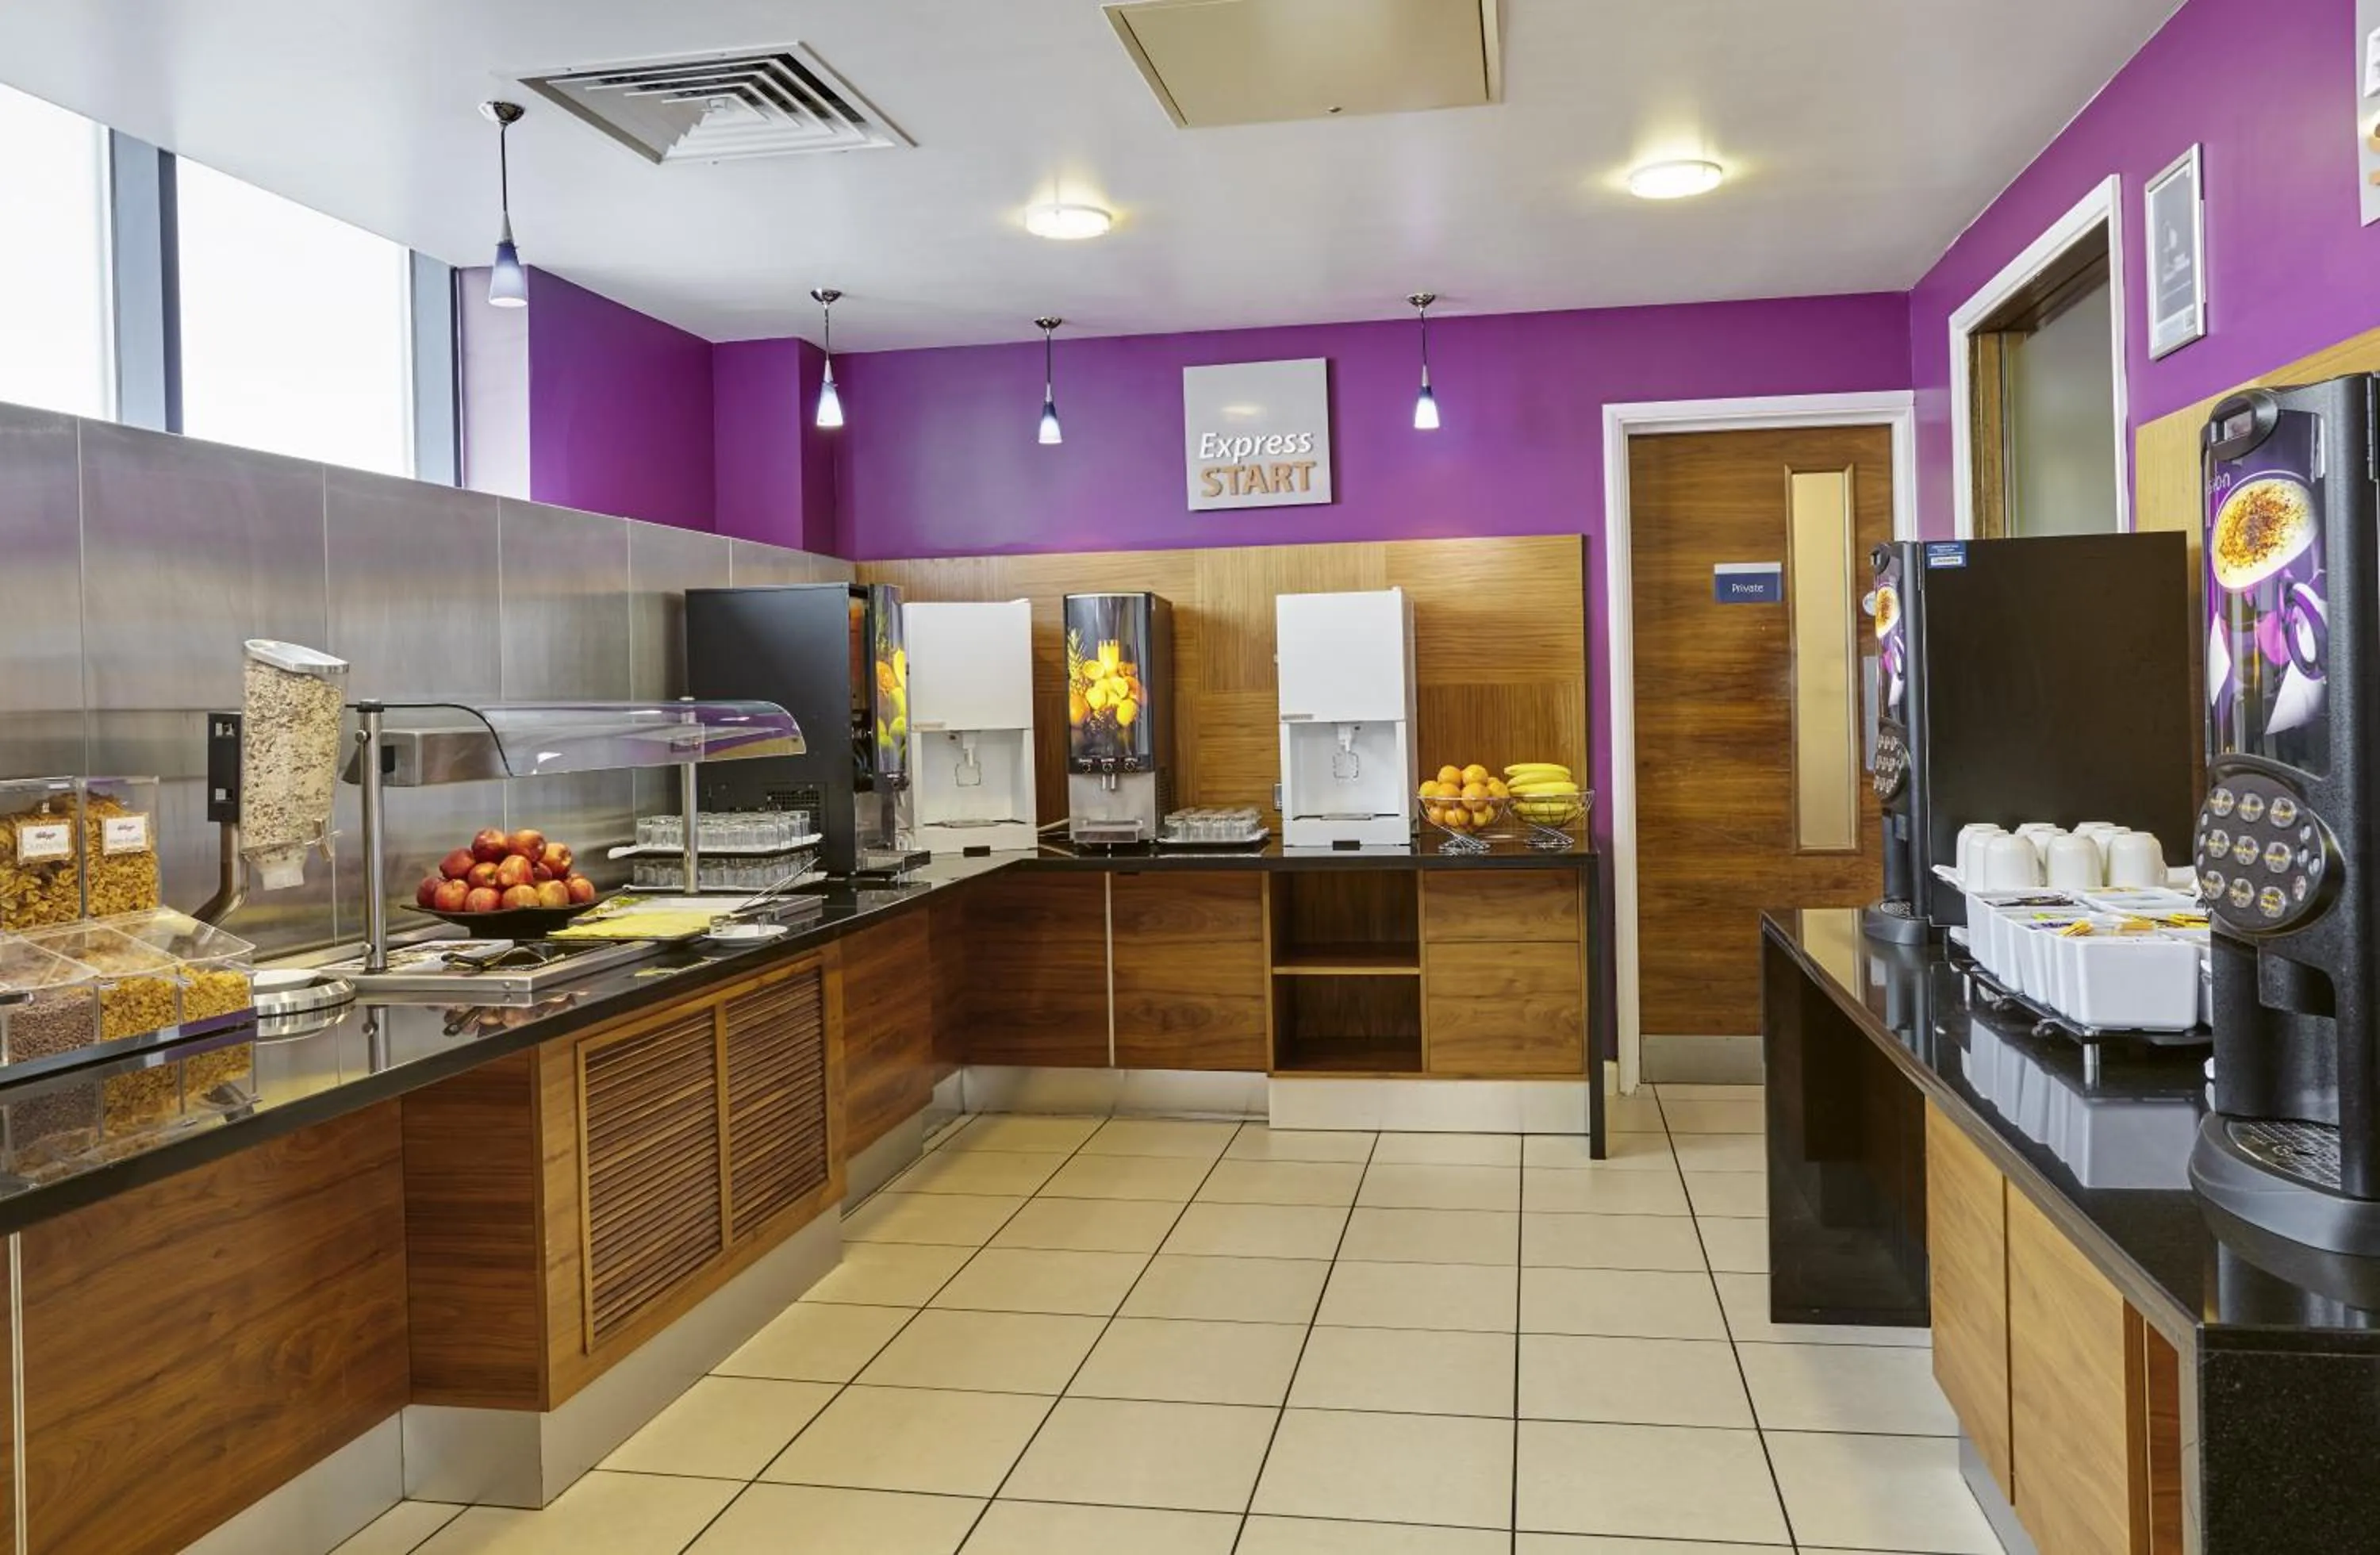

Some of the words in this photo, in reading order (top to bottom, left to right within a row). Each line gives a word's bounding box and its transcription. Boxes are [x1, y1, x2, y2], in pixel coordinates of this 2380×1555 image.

[1199, 432, 1313, 464] Express
[1200, 461, 1317, 498] START
[1732, 583, 1764, 593] Private
